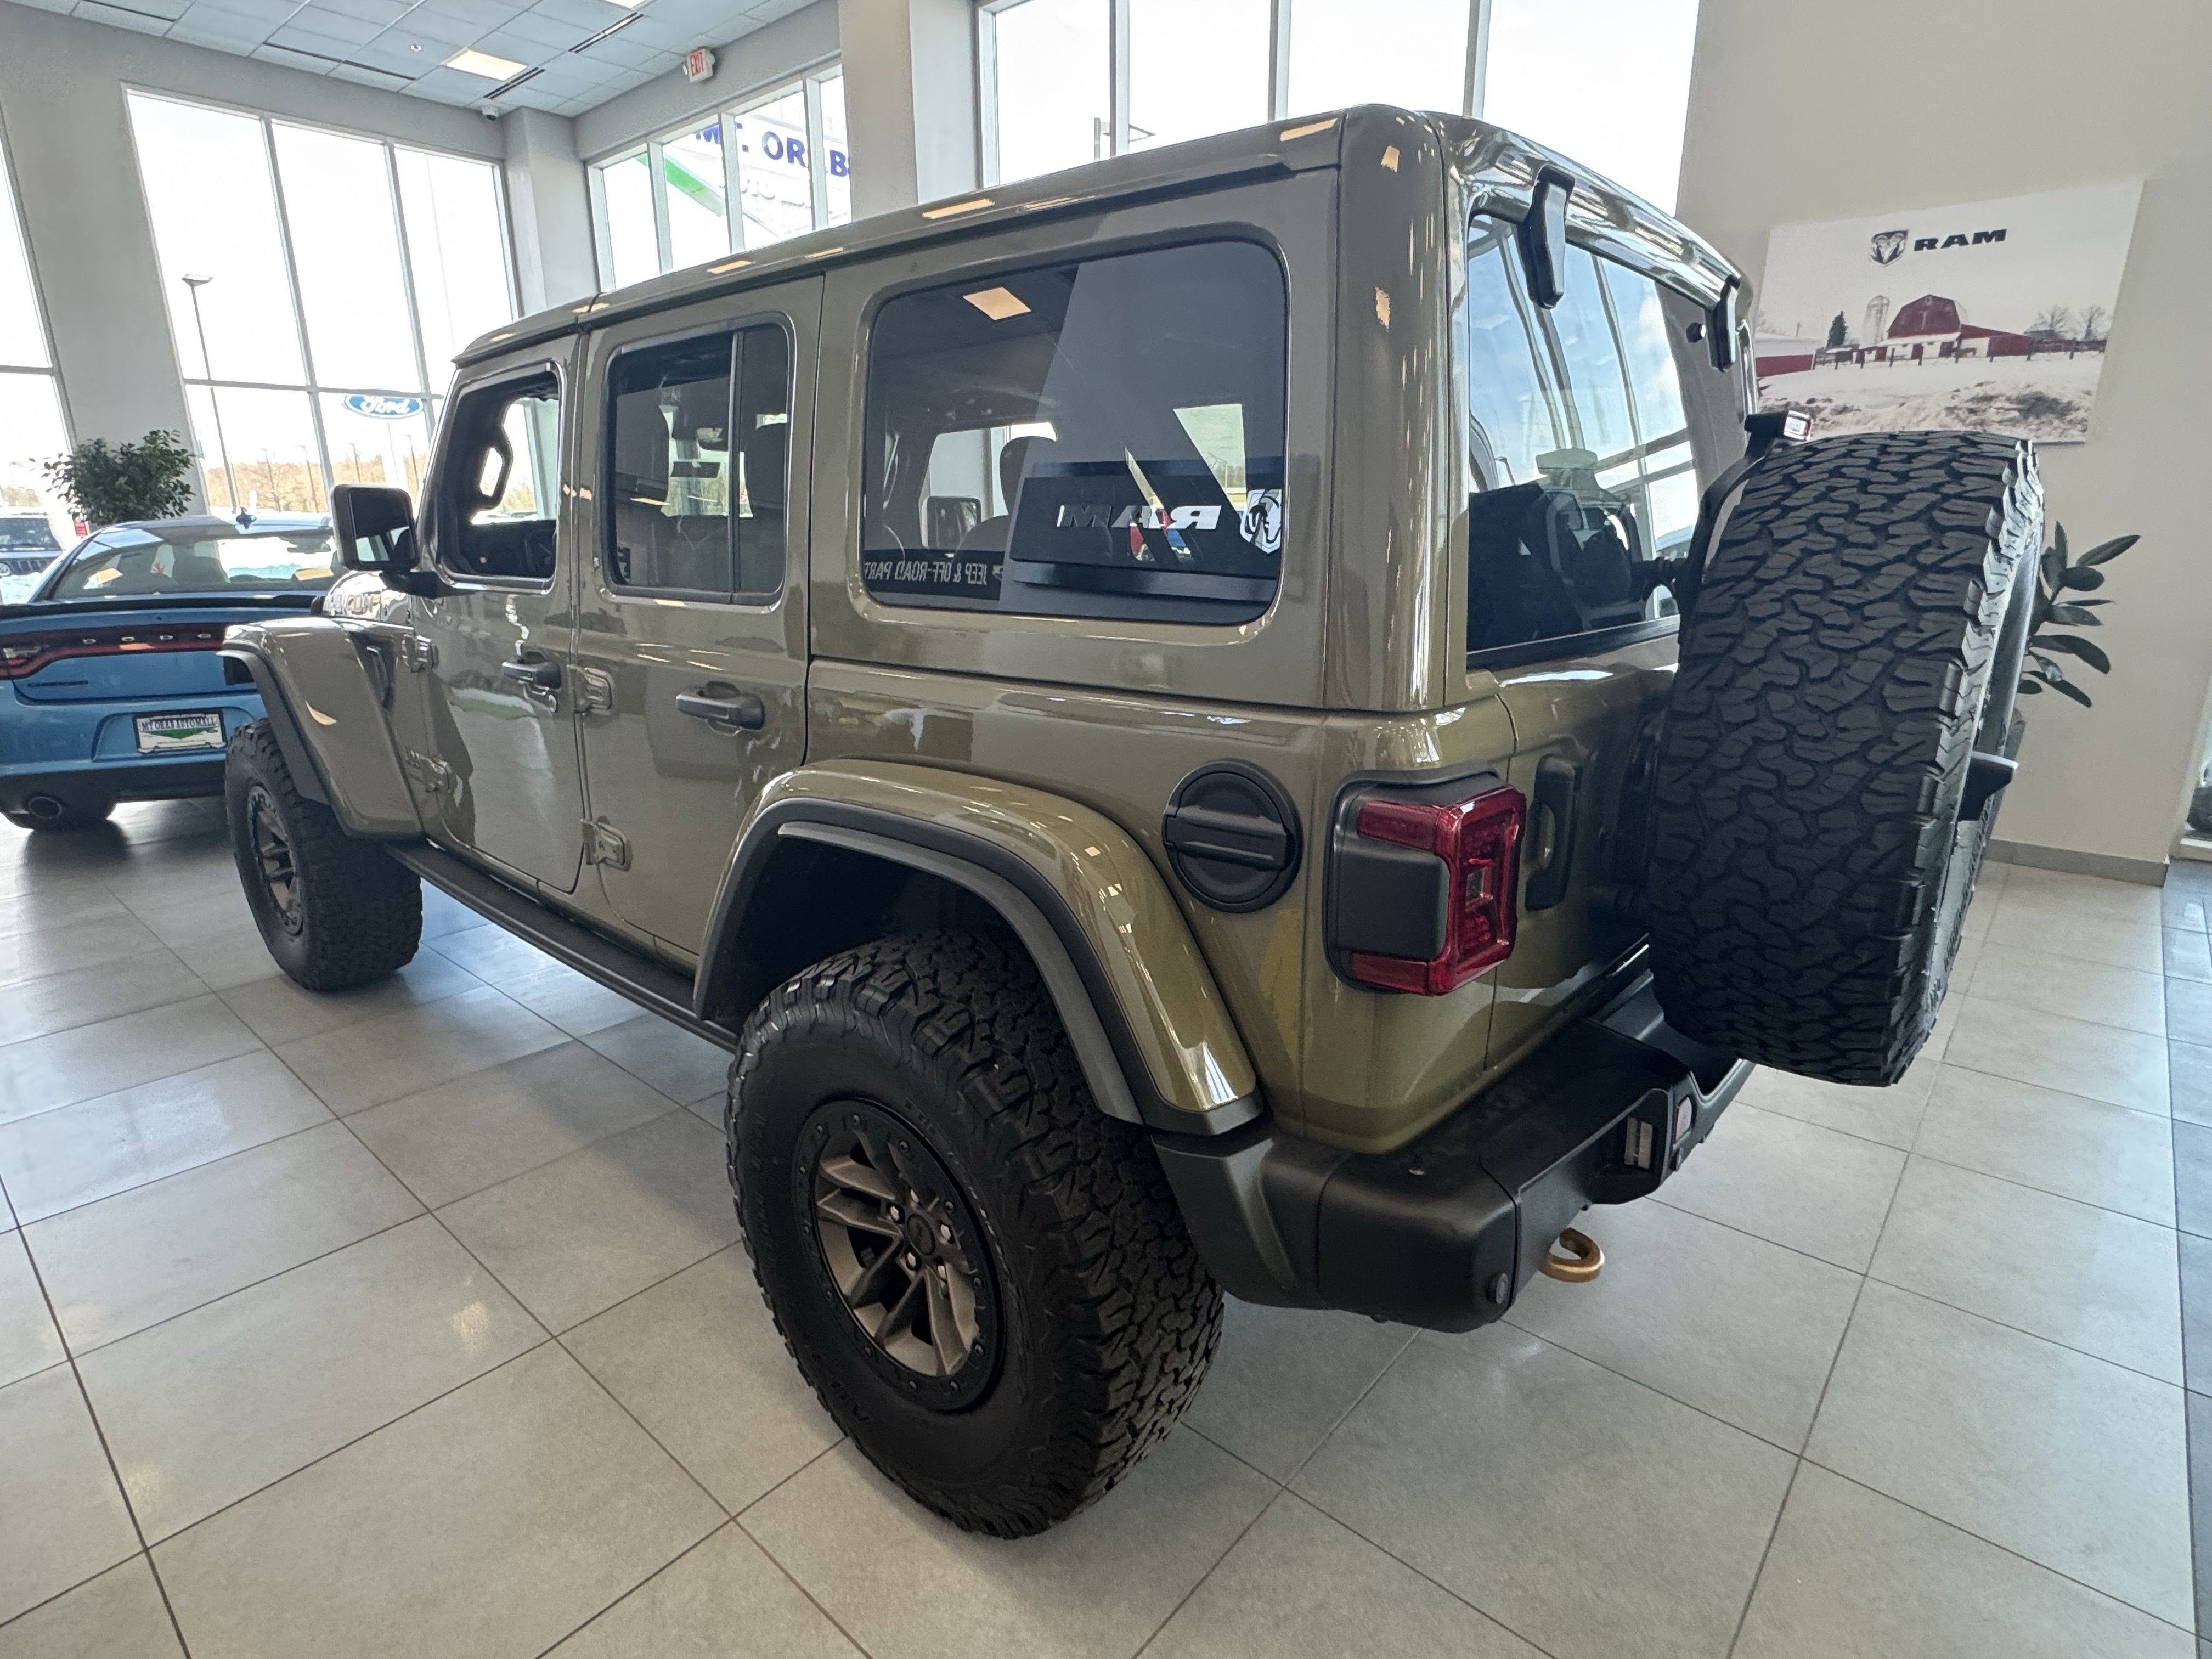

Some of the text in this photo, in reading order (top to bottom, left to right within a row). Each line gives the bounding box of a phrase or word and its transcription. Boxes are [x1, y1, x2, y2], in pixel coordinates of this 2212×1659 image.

[690, 50, 704, 76] EXIT
[761, 131, 850, 177] ORB
[1914, 228, 2007, 251] RAM
[360, 394, 410, 414] Ford
